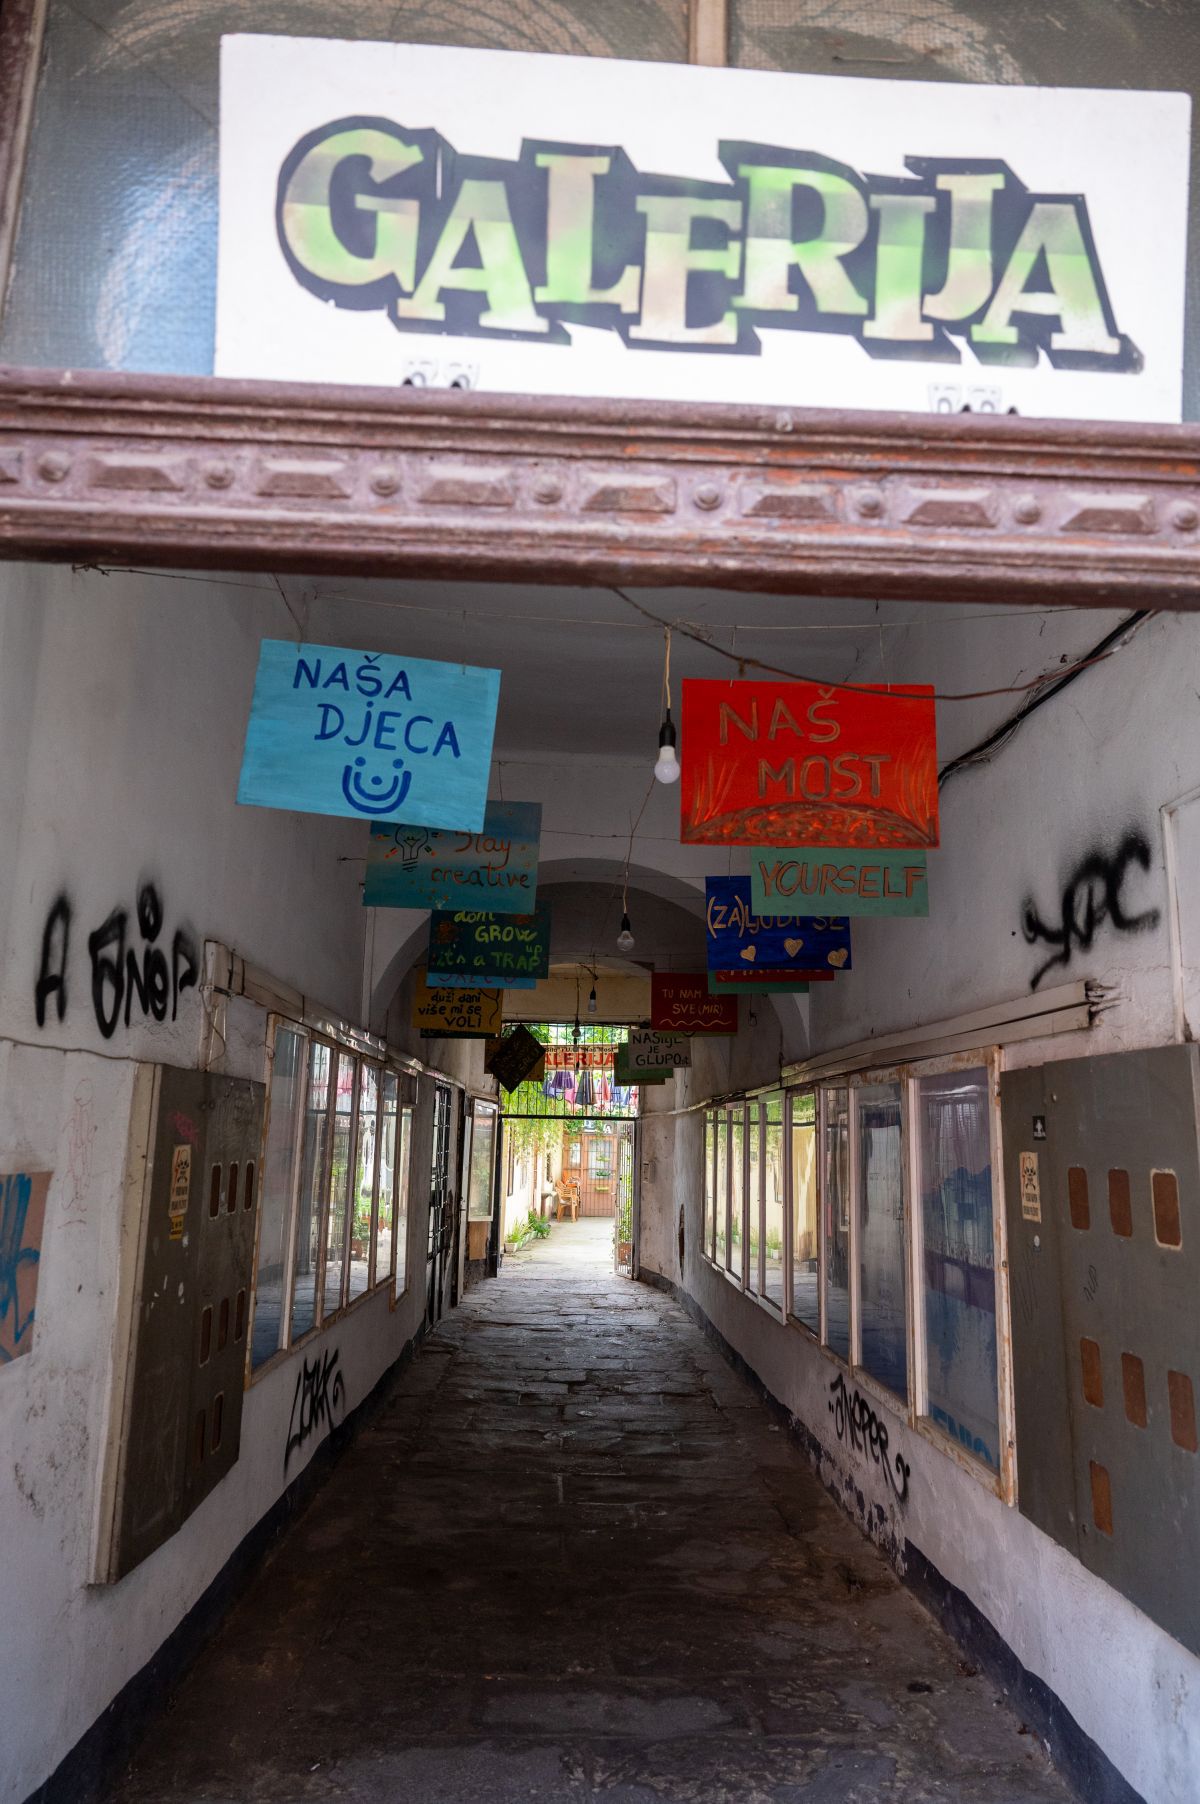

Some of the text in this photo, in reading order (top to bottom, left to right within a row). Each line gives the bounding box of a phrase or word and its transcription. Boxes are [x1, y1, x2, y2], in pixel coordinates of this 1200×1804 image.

[276, 115, 1144, 373] GALERIJA
[293, 652, 412, 701] NAŠA
[718, 687, 840, 745] NAŠ
[757, 752, 892, 800] MOST
[431, 862, 530, 888] creative
[758, 861, 927, 898] YOURSELF
[490, 951, 542, 972] TRAP
[679, 988, 702, 999] NAM
[417, 1003, 447, 1015] više
[450, 1004, 463, 1014] mi
[545, 1052, 614, 1066] ALERIJA
[648, 1045, 660, 1054] JE
